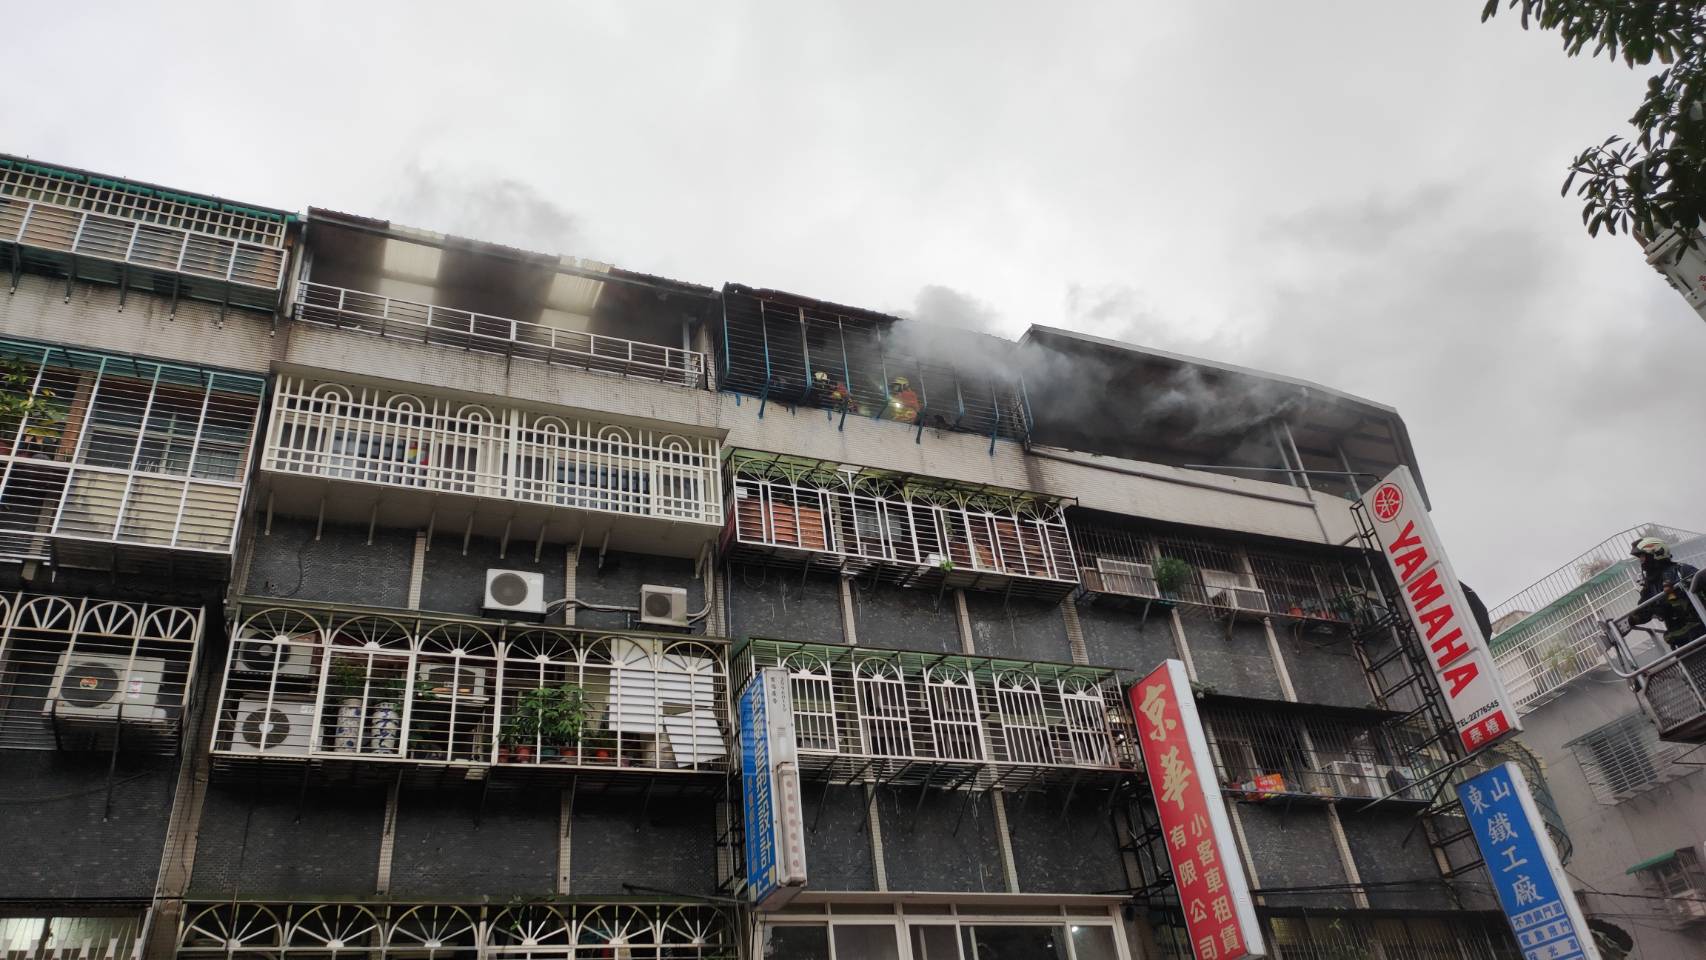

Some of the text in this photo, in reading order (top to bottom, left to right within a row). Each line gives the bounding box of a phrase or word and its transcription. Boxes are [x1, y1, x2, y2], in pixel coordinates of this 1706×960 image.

[1389, 520, 1479, 699] YAMAHA
[1169, 824, 1218, 960] 有限公司
[1191, 813, 1240, 955] 小客車租賃
